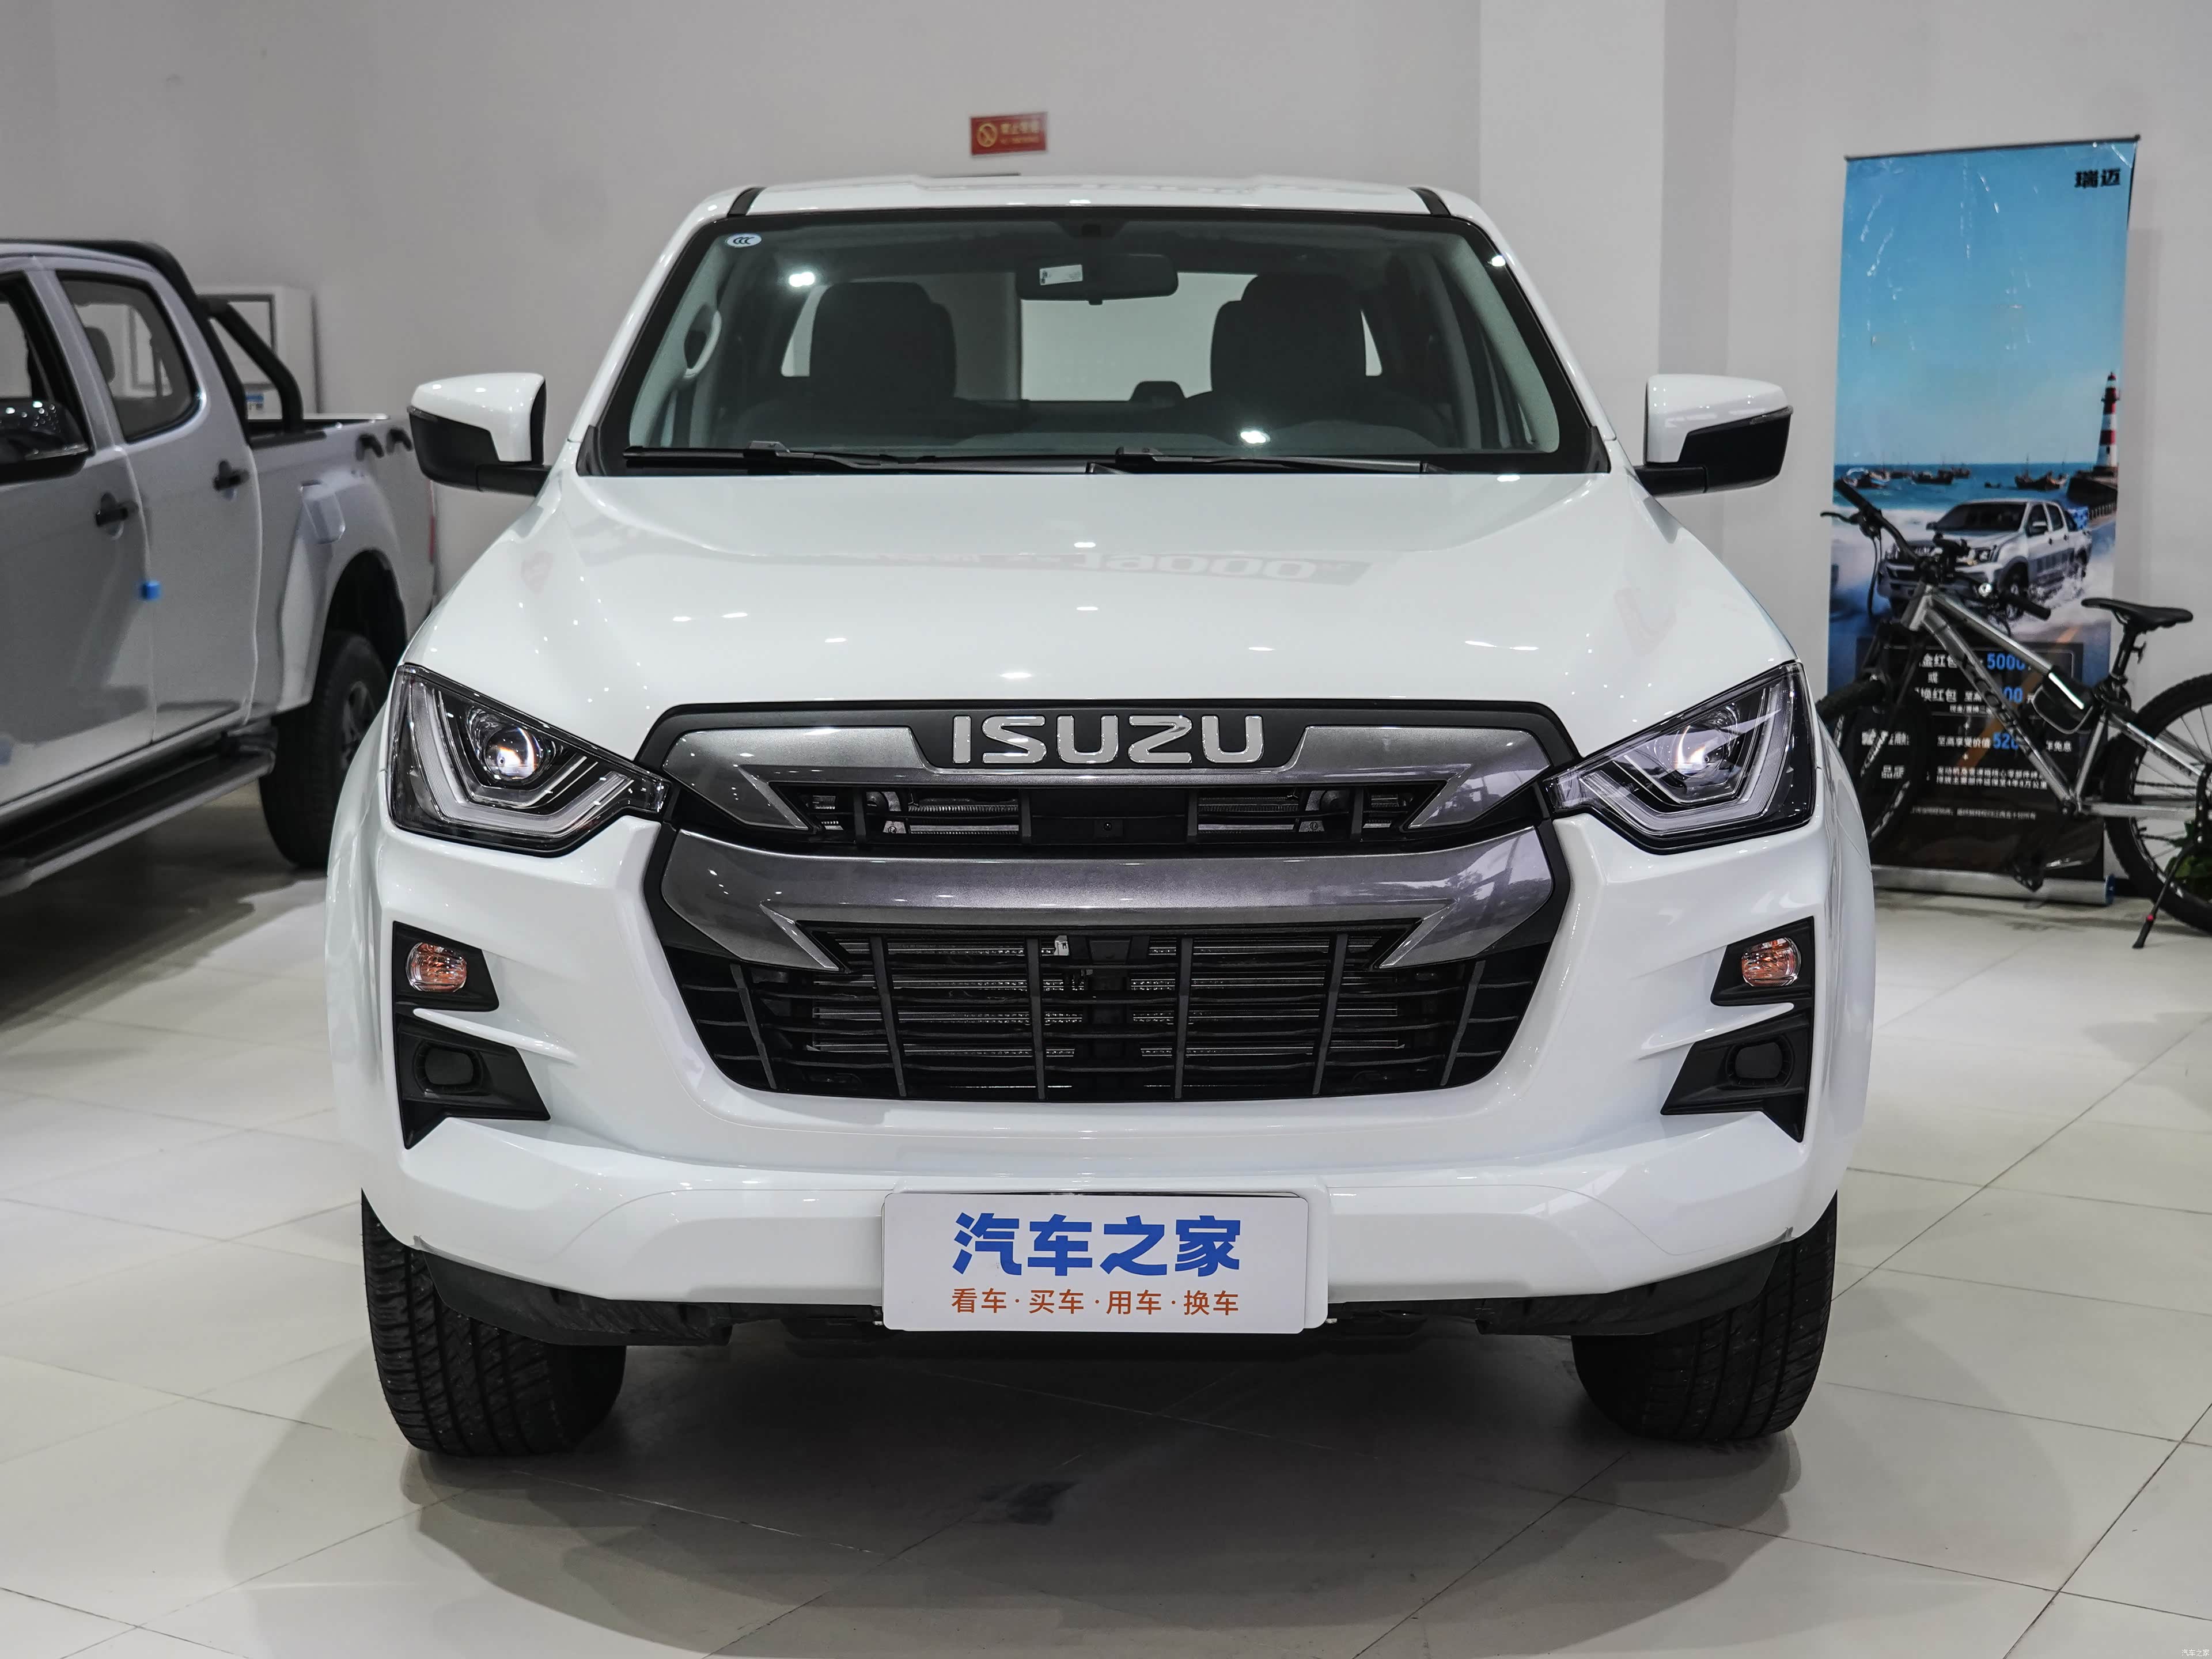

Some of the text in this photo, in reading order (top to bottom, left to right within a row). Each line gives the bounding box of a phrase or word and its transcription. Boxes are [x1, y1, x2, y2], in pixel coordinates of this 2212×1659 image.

[2075, 169, 2120, 188] 瑞迈
[1915, 687, 1957, 702] 换红包
[953, 715, 1264, 764] ISUZU
[952, 1213, 1241, 1277] 汽车之家
